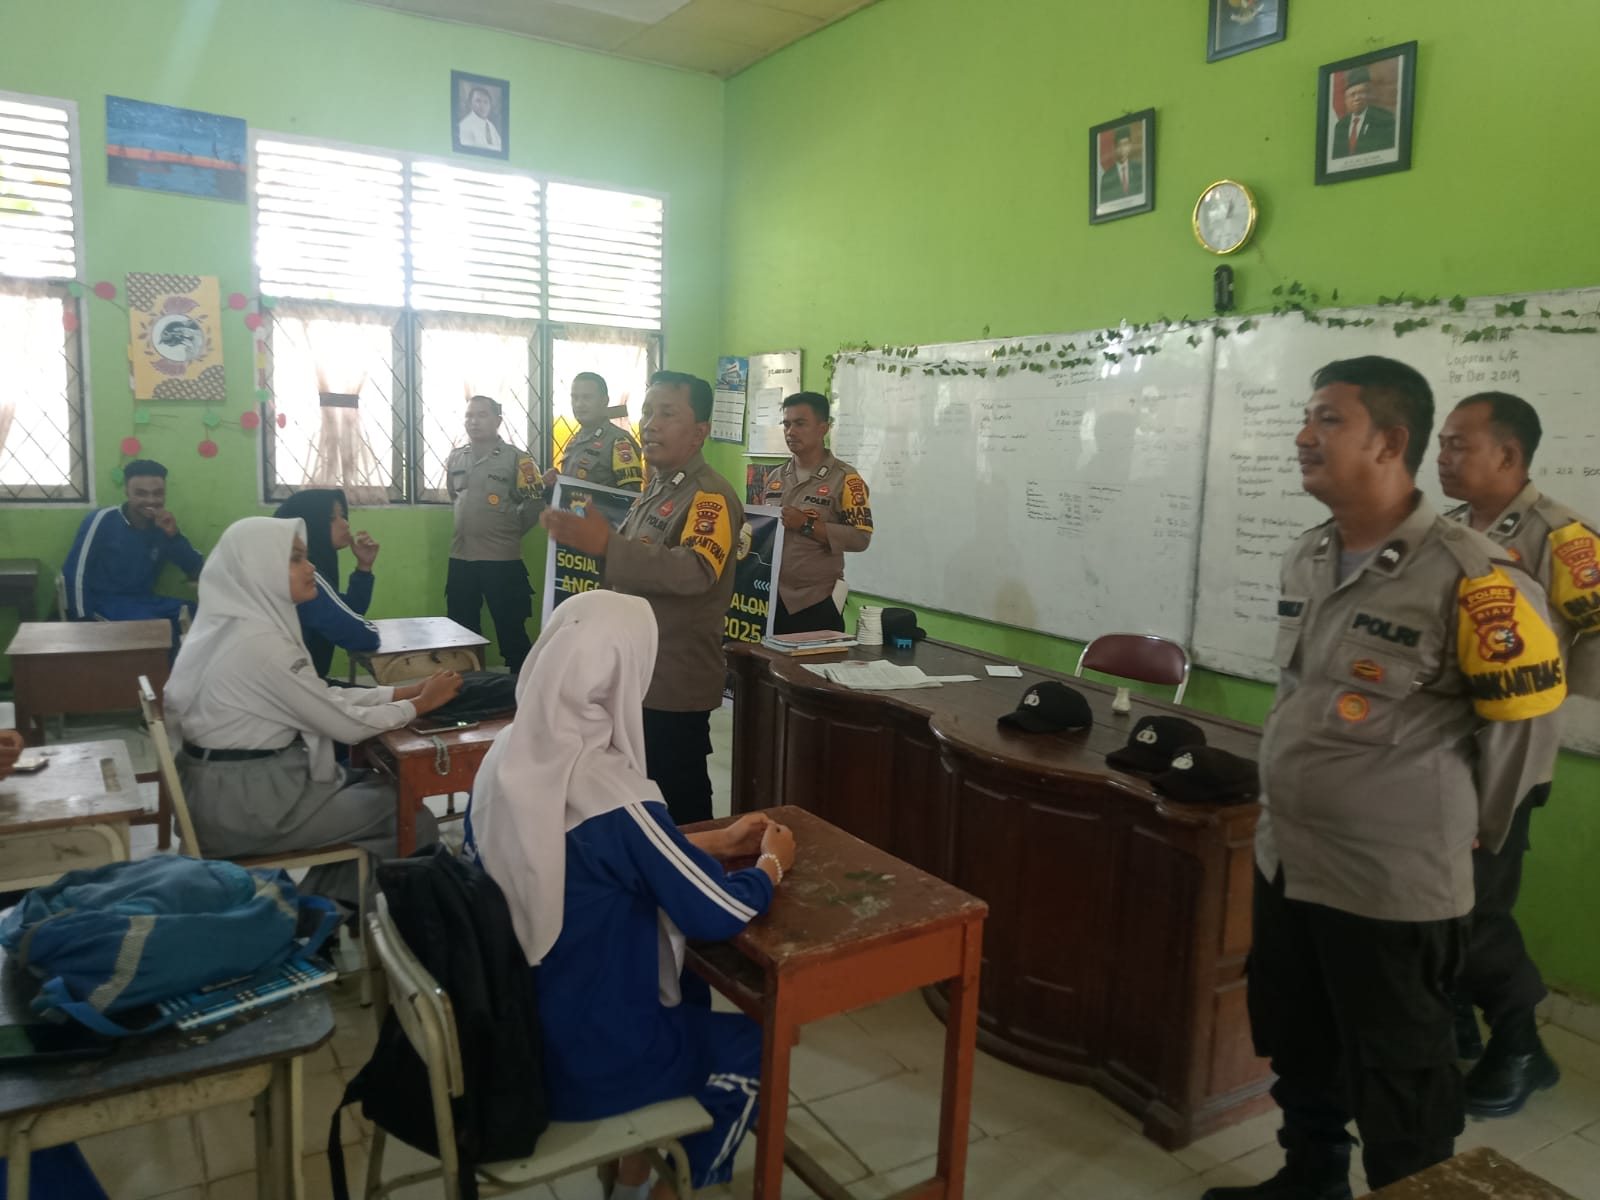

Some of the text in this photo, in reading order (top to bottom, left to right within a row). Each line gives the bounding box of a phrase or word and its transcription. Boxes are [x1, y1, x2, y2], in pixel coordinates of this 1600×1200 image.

[1490, 369, 1520, 383] 2019
[804, 496, 831, 506] POLRI
[557, 552, 600, 575] SOSIAL
[730, 593, 769, 618] ALON
[1352, 612, 1423, 649] POLRI
